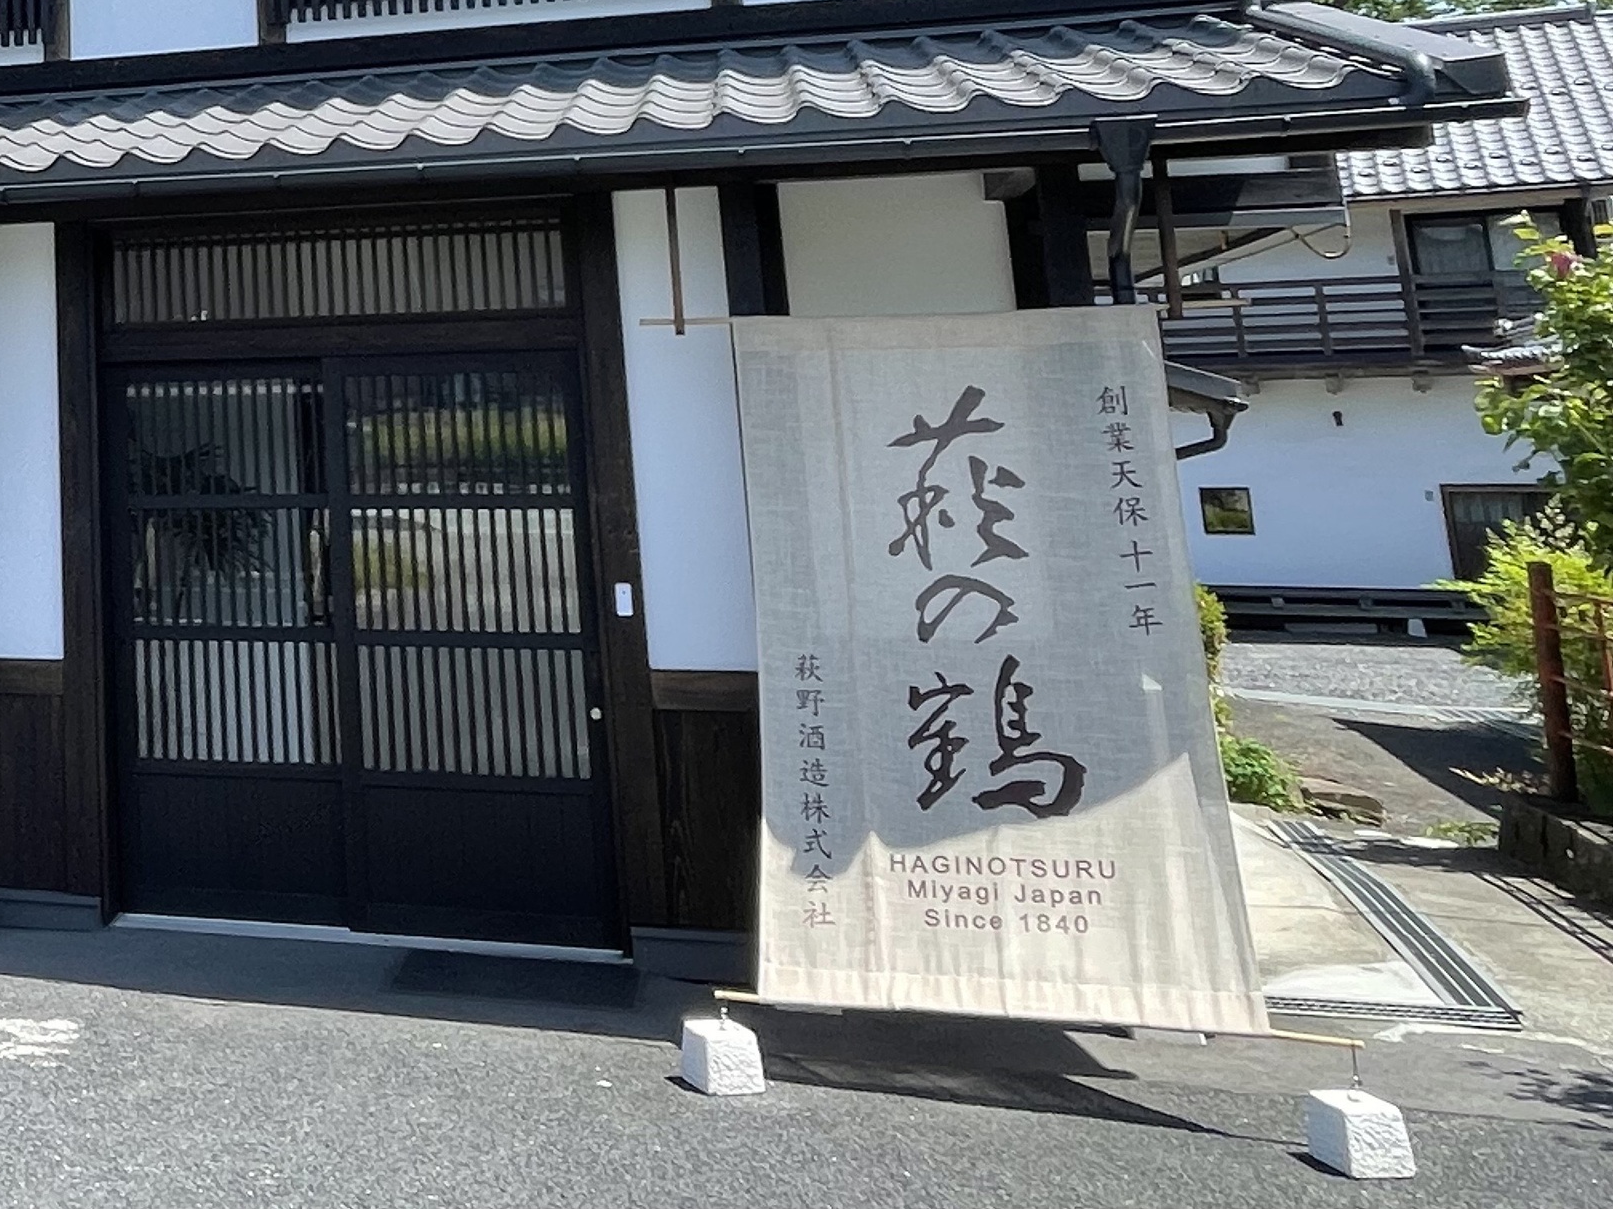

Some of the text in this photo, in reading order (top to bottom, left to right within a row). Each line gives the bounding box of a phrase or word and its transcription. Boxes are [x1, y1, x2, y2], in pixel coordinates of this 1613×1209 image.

[1095, 385, 1163, 636] 創業天保十一年
[887, 385, 1087, 818] 萩の鶴
[794, 653, 836, 929] 萩野酒造株式会社
[890, 853, 1116, 879] HAGINOTSURU
[907, 879, 1102, 908] Miyagi Japan
[924, 908, 1089, 934] Since 1840
